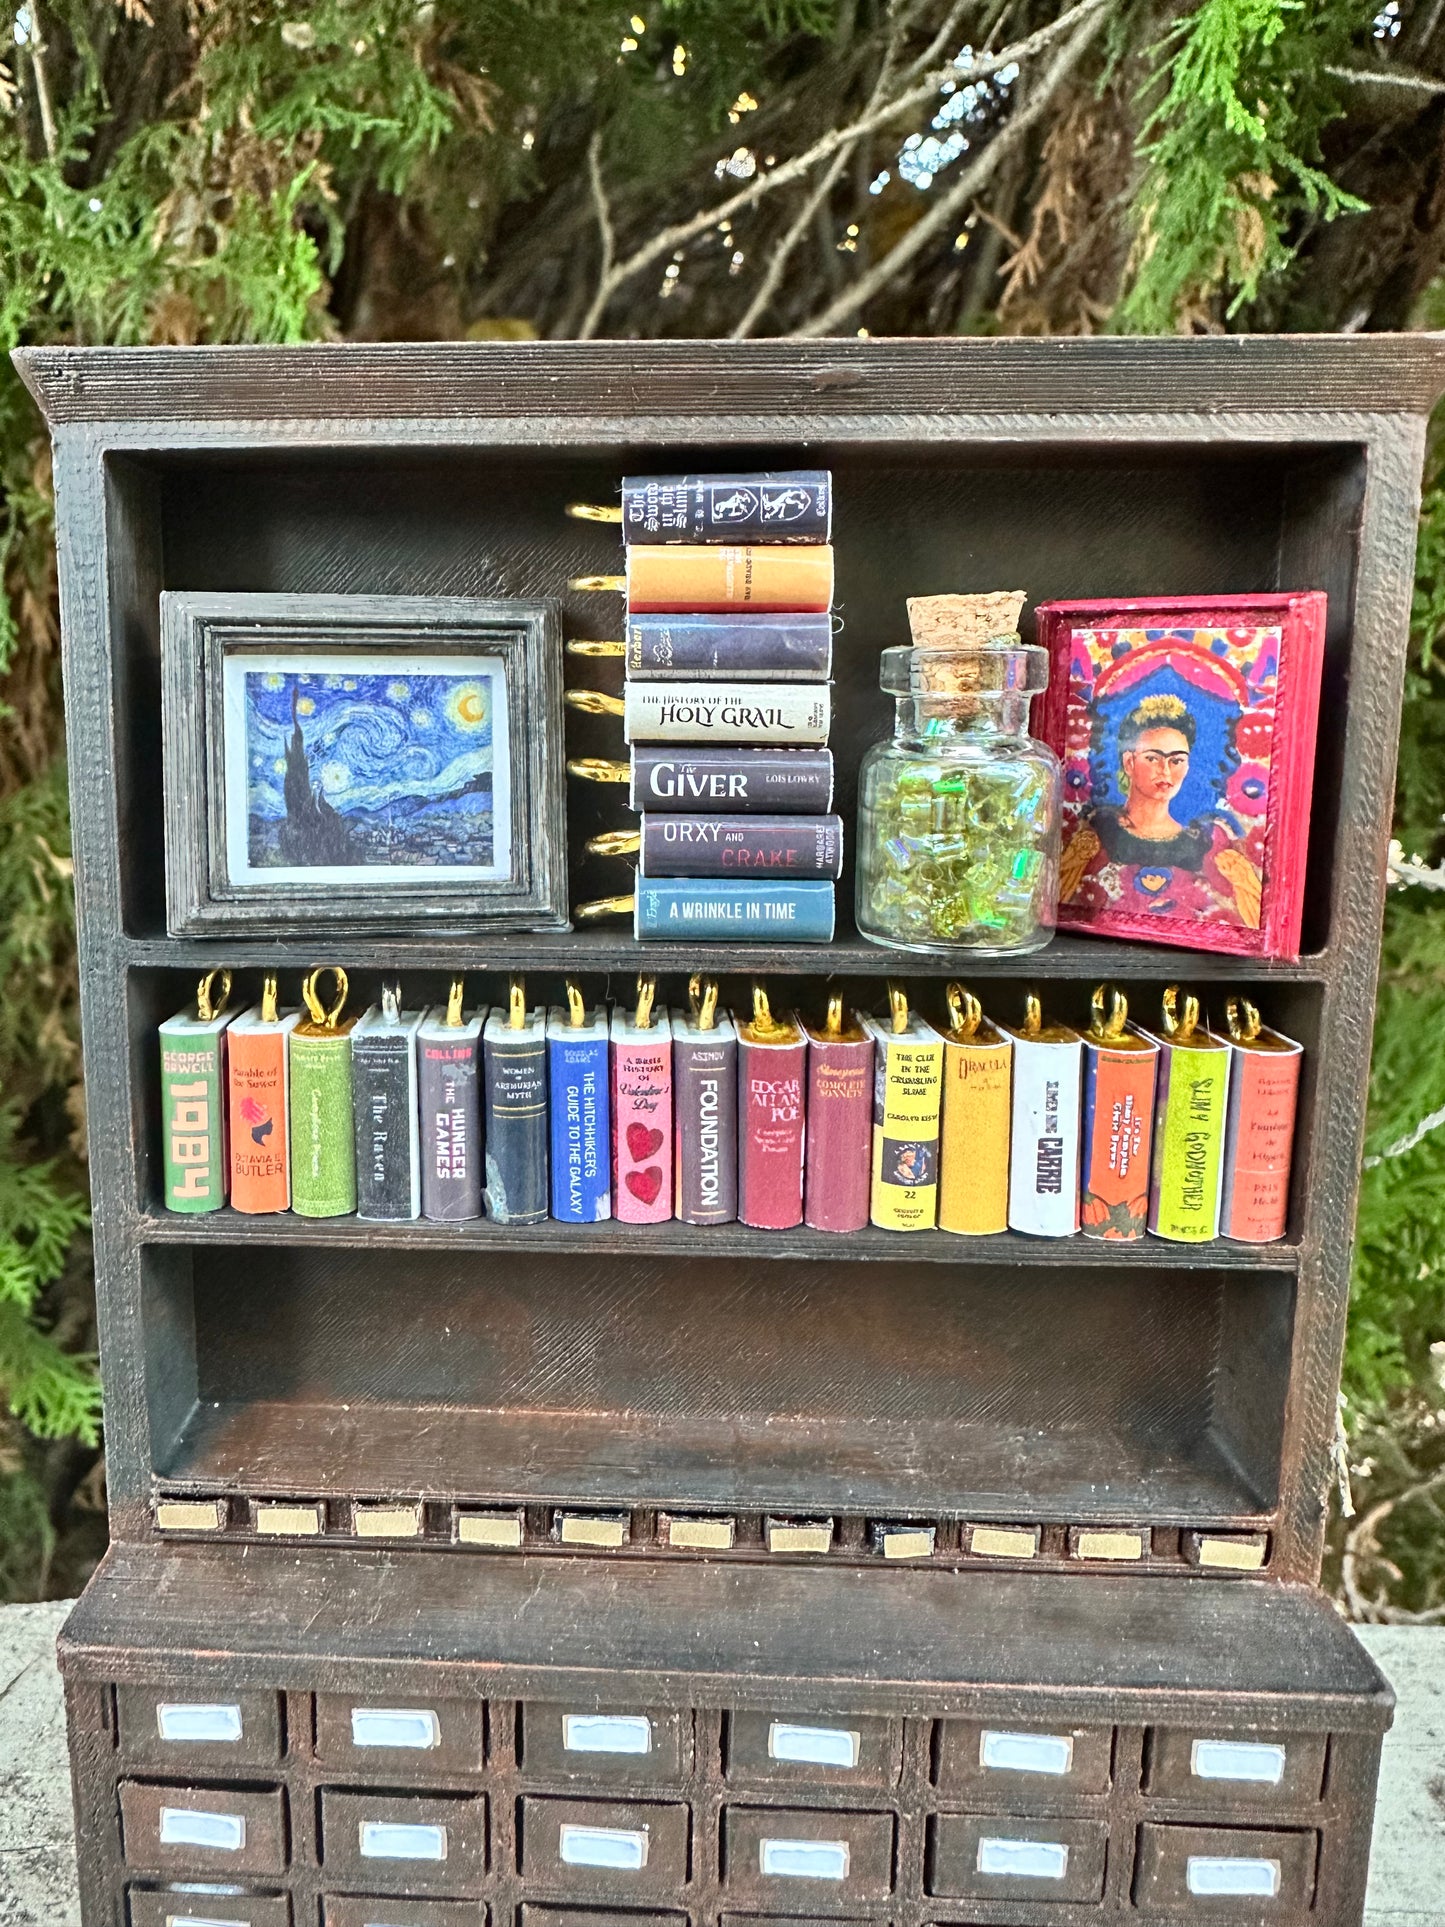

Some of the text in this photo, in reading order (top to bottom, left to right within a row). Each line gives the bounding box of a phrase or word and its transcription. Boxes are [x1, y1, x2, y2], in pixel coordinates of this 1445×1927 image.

[643, 482, 660, 532] Sword
[642, 695, 742, 705] THE HISTORY OF THE
[660, 706, 718, 727] HOLY
[721, 707, 795, 729] GRAIL
[650, 762, 748, 797] GIVER
[765, 774, 821, 784] LOIS LOWRY
[663, 823, 744, 842] ORXY AND
[721, 849, 798, 868] CRAKE
[669, 903, 796, 919] A WRINKLE IN TIME
[163, 1051, 214, 1062] GEORGE
[691, 1051, 725, 1061] ASIMOV
[164, 1060, 214, 1073] ORWELL
[502, 1066, 535, 1075] WOMEN
[915, 1065, 930, 1073] THE
[445, 1081, 455, 1104] THE
[620, 1083, 669, 1096] Valentine's
[751, 1079, 800, 1094] EDGAR
[506, 1091, 532, 1099] MYTH
[752, 1093, 800, 1107] ALLAN
[1189, 1077, 1214, 1122] SLIMY
[632, 1097, 659, 1113] Day
[771, 1106, 800, 1122] POE
[584, 1071, 597, 1178] THE HITCHHIKER'S
[170, 1080, 210, 1198] 1984
[371, 1093, 388, 1181] The Raven
[451, 1108, 466, 1179] HUNGER
[699, 1079, 719, 1206] FOUNDATION
[435, 1112, 450, 1179] GAMES
[566, 1086, 583, 1215] GUIDE TO THE GALAXY
[236, 1162, 283, 1177] BUTLER
[1036, 1137, 1063, 1195] CARRIE
[904, 1190, 916, 1199] 22
